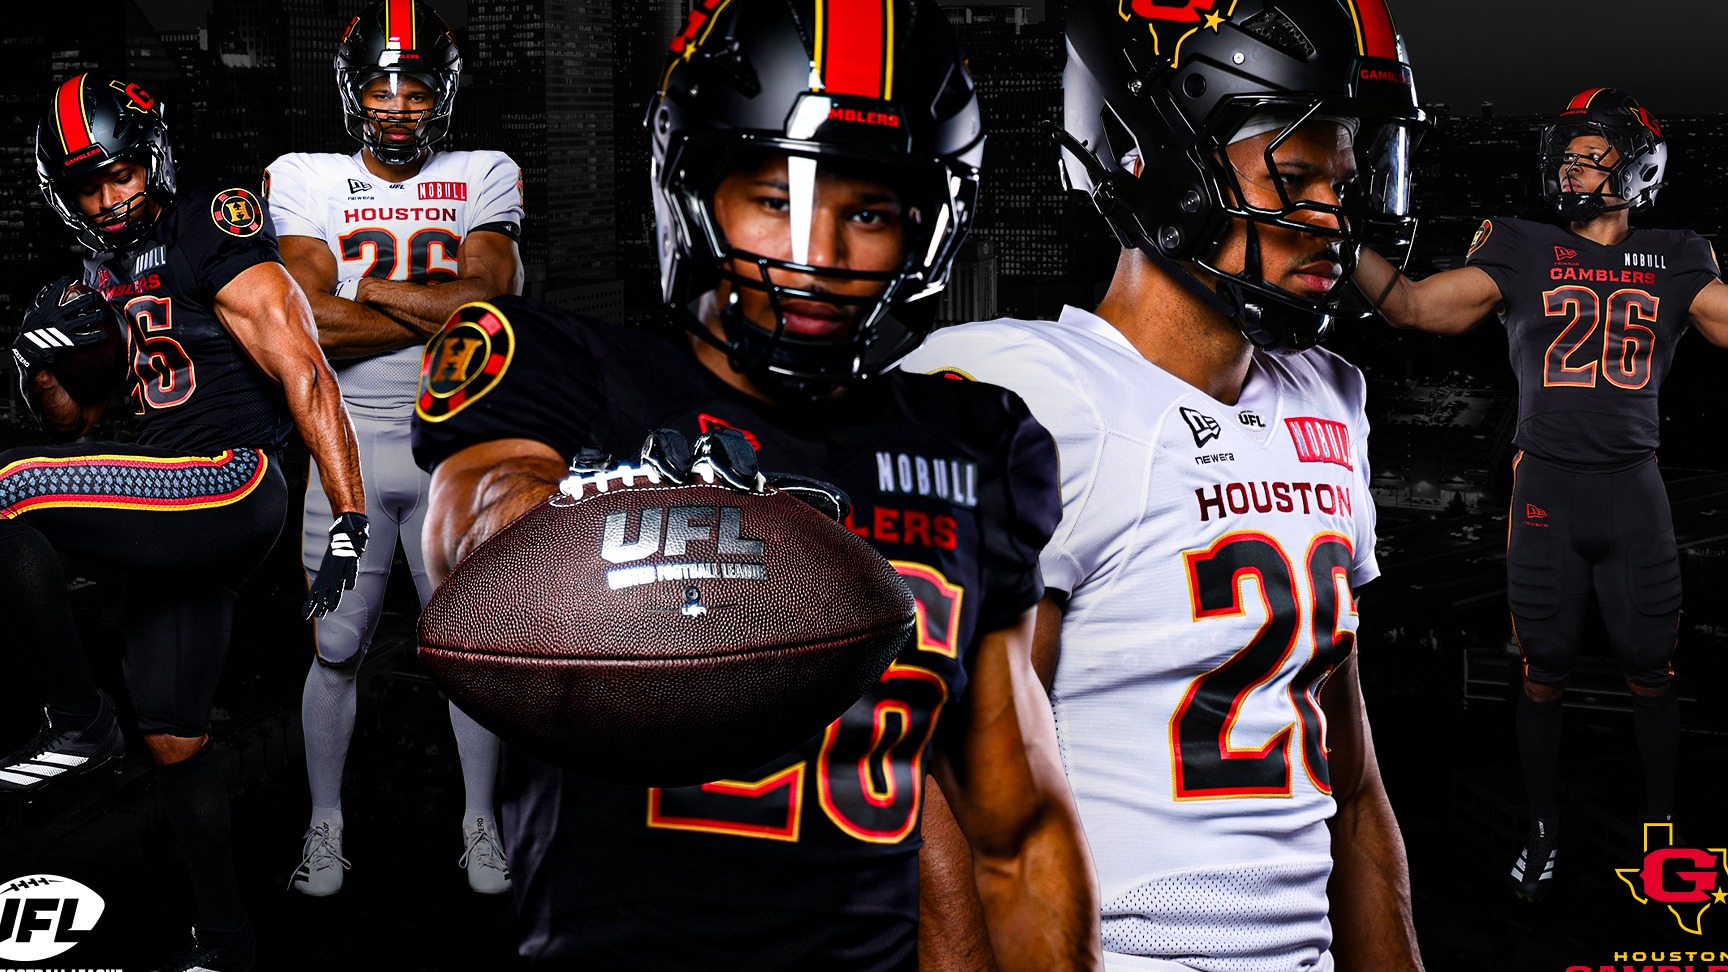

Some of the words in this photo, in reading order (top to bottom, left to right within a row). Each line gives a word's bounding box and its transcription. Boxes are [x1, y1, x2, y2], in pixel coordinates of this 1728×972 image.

[828, 107, 900, 128] MBLERS
[64, 147, 102, 167] GAMBLERS
[418, 182, 467, 200] NOBULL
[344, 207, 457, 223] HOUSTON
[1550, 267, 1656, 285] GAMBLERS
[1624, 252, 1667, 270] NOBULL
[123, 295, 197, 412] 6
[1542, 284, 1661, 390] 26
[1237, 412, 1267, 428] UFL
[1291, 420, 1354, 469] NOBULL
[875, 451, 978, 507] NOBULL
[1195, 481, 1352, 522] HOUSTON
[601, 505, 765, 564] UFL
[844, 503, 959, 551] LERS
[1169, 529, 1359, 803] 26
